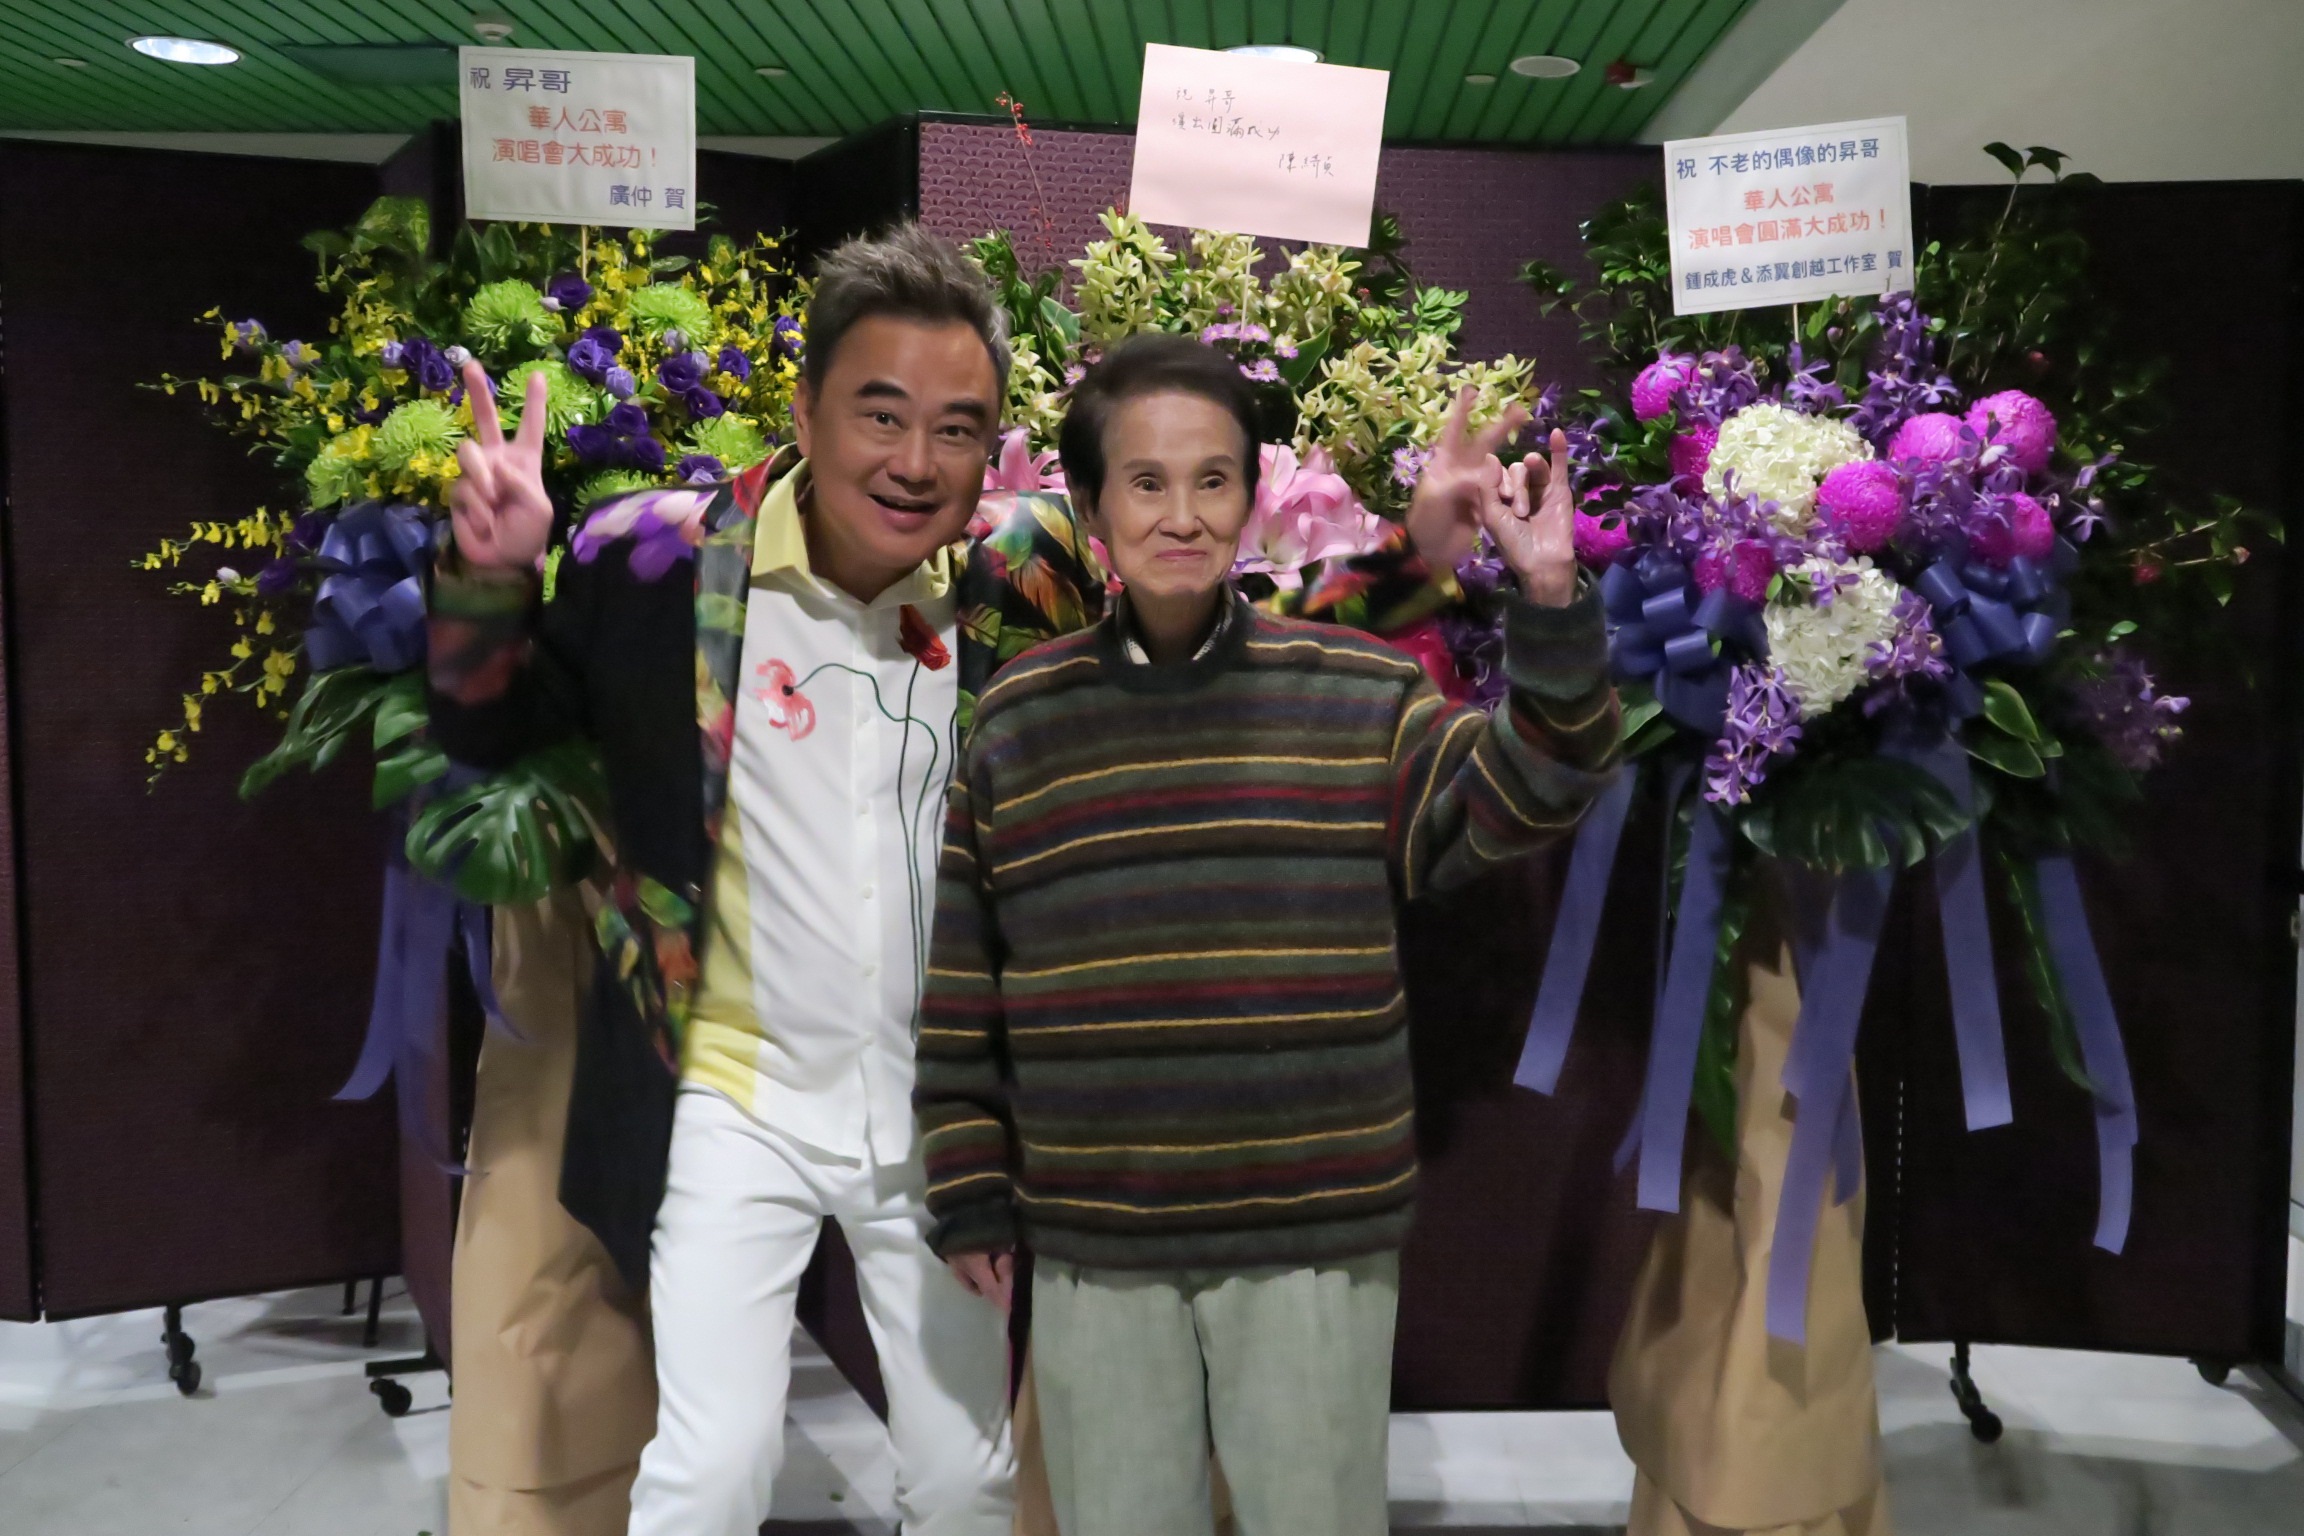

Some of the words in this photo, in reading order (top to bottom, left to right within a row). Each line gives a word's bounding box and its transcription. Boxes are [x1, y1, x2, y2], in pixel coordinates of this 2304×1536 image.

[470, 68, 491, 90] 祝
[503, 68, 571, 93] 昇哥
[528, 105, 627, 134] 華人公寓
[492, 138, 657, 169] 演唱會大成功！
[1676, 159, 1697, 179] 祝
[1708, 138, 1880, 176] 不老的偶像的昇哥
[610, 185, 652, 207] 廣仲
[665, 188, 685, 209] 賀
[1744, 182, 1834, 212] 華人公寓
[1888, 250, 1902, 269] 賀
